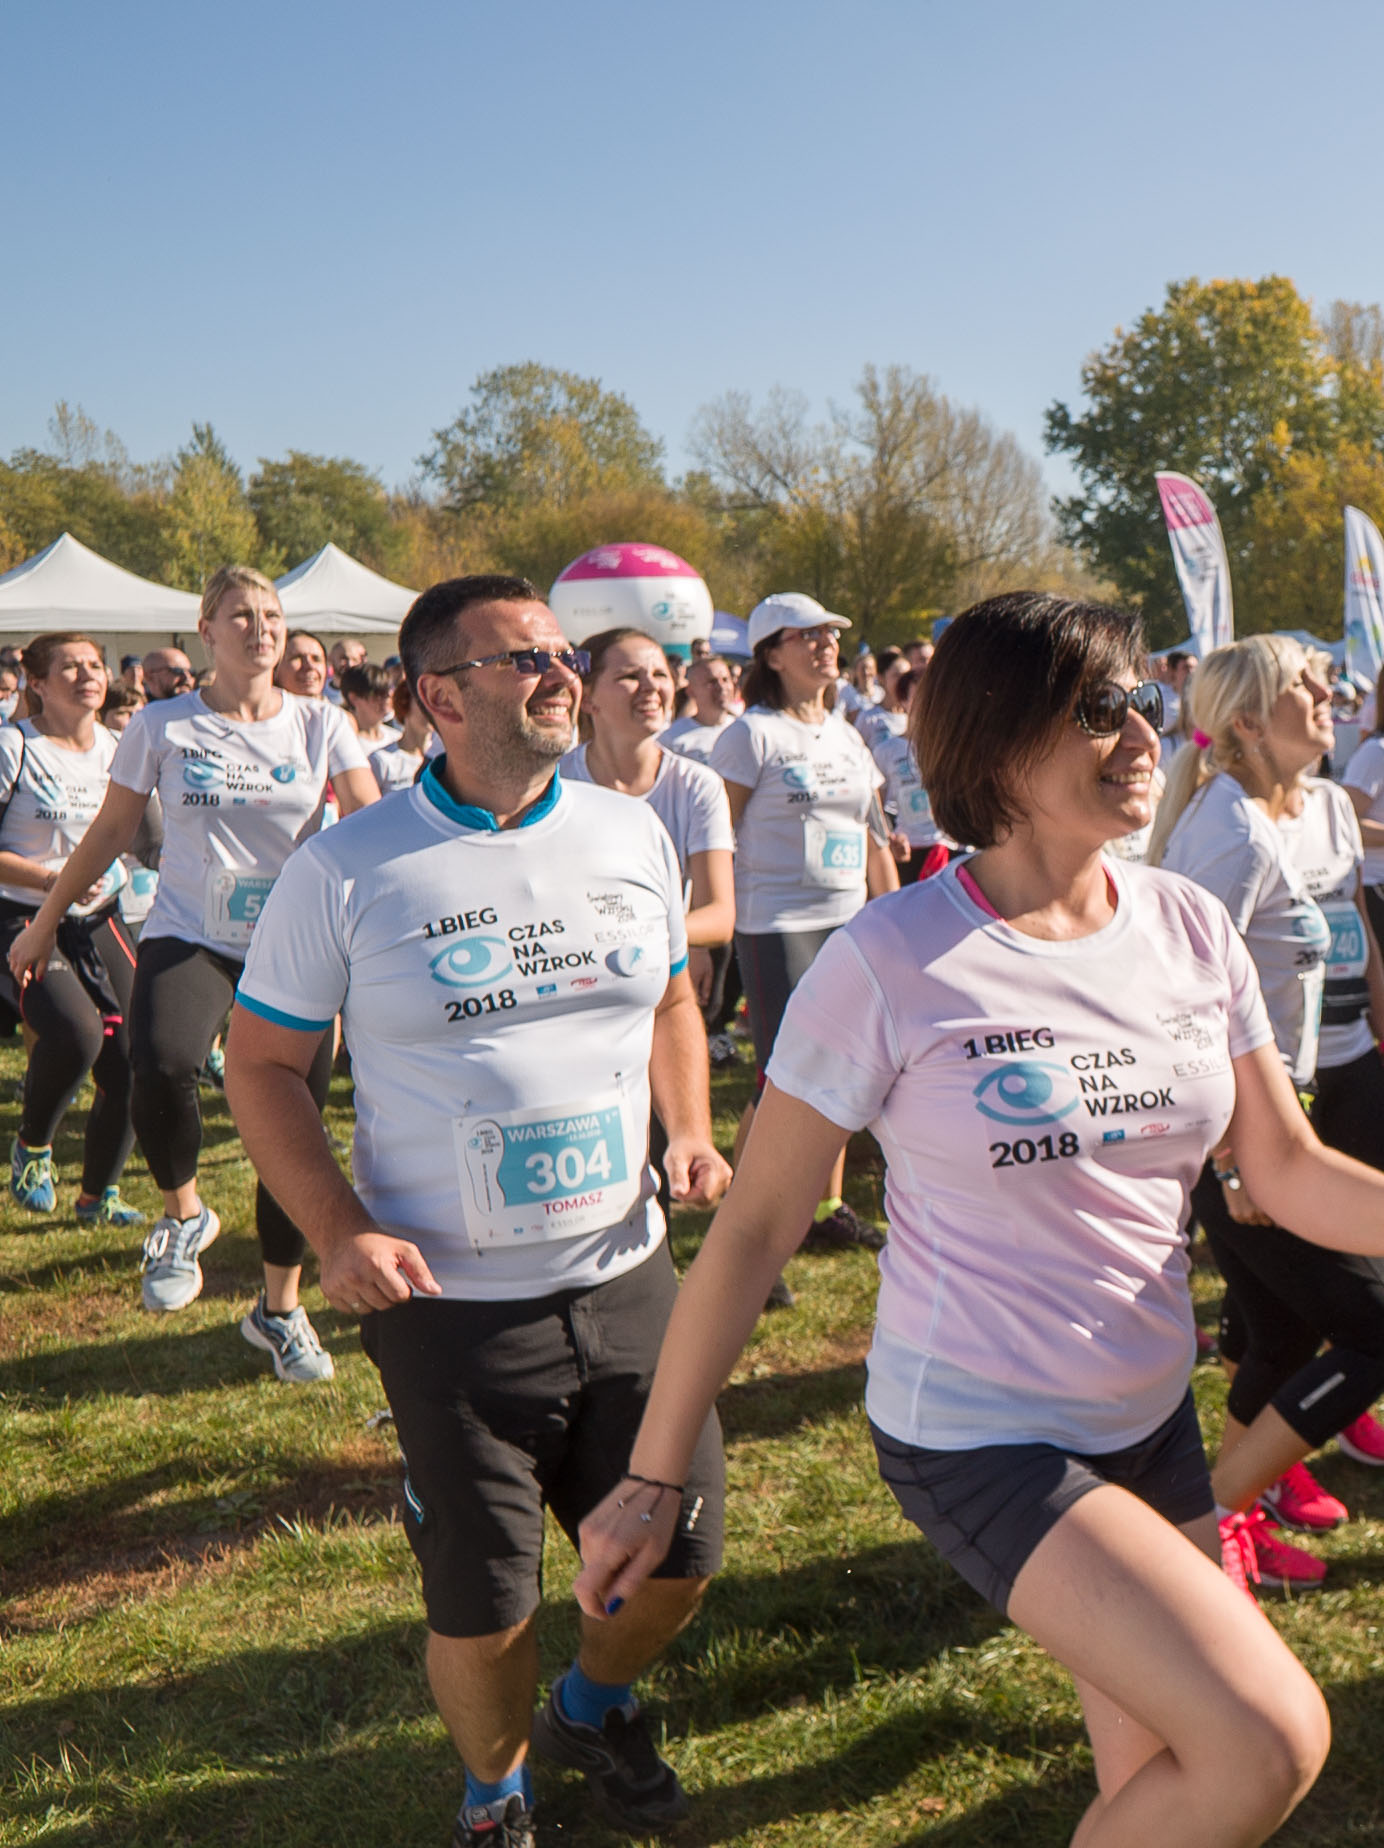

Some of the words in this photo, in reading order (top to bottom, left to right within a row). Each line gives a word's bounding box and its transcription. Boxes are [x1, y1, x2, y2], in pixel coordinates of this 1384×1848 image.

[182, 793, 220, 808] 2018
[226, 782, 273, 793] WZROK
[786, 791, 820, 804] 2018
[830, 843, 860, 867] 635
[422, 907, 499, 940] 1.BIEG
[508, 919, 566, 942] CZAS
[512, 941, 548, 961] NA
[516, 950, 598, 978] WZROK
[444, 989, 518, 1023] 2018
[963, 1028, 1056, 1060] 1.BIEG
[1070, 1048, 1137, 1072] CZAS
[1077, 1074, 1119, 1094] NA
[1085, 1088, 1177, 1118] WZROK
[507, 1115, 600, 1144] WARSZAWA
[989, 1132, 1081, 1169] 2018
[525, 1139, 612, 1195] 304
[542, 1190, 605, 1217] TOMASZ
